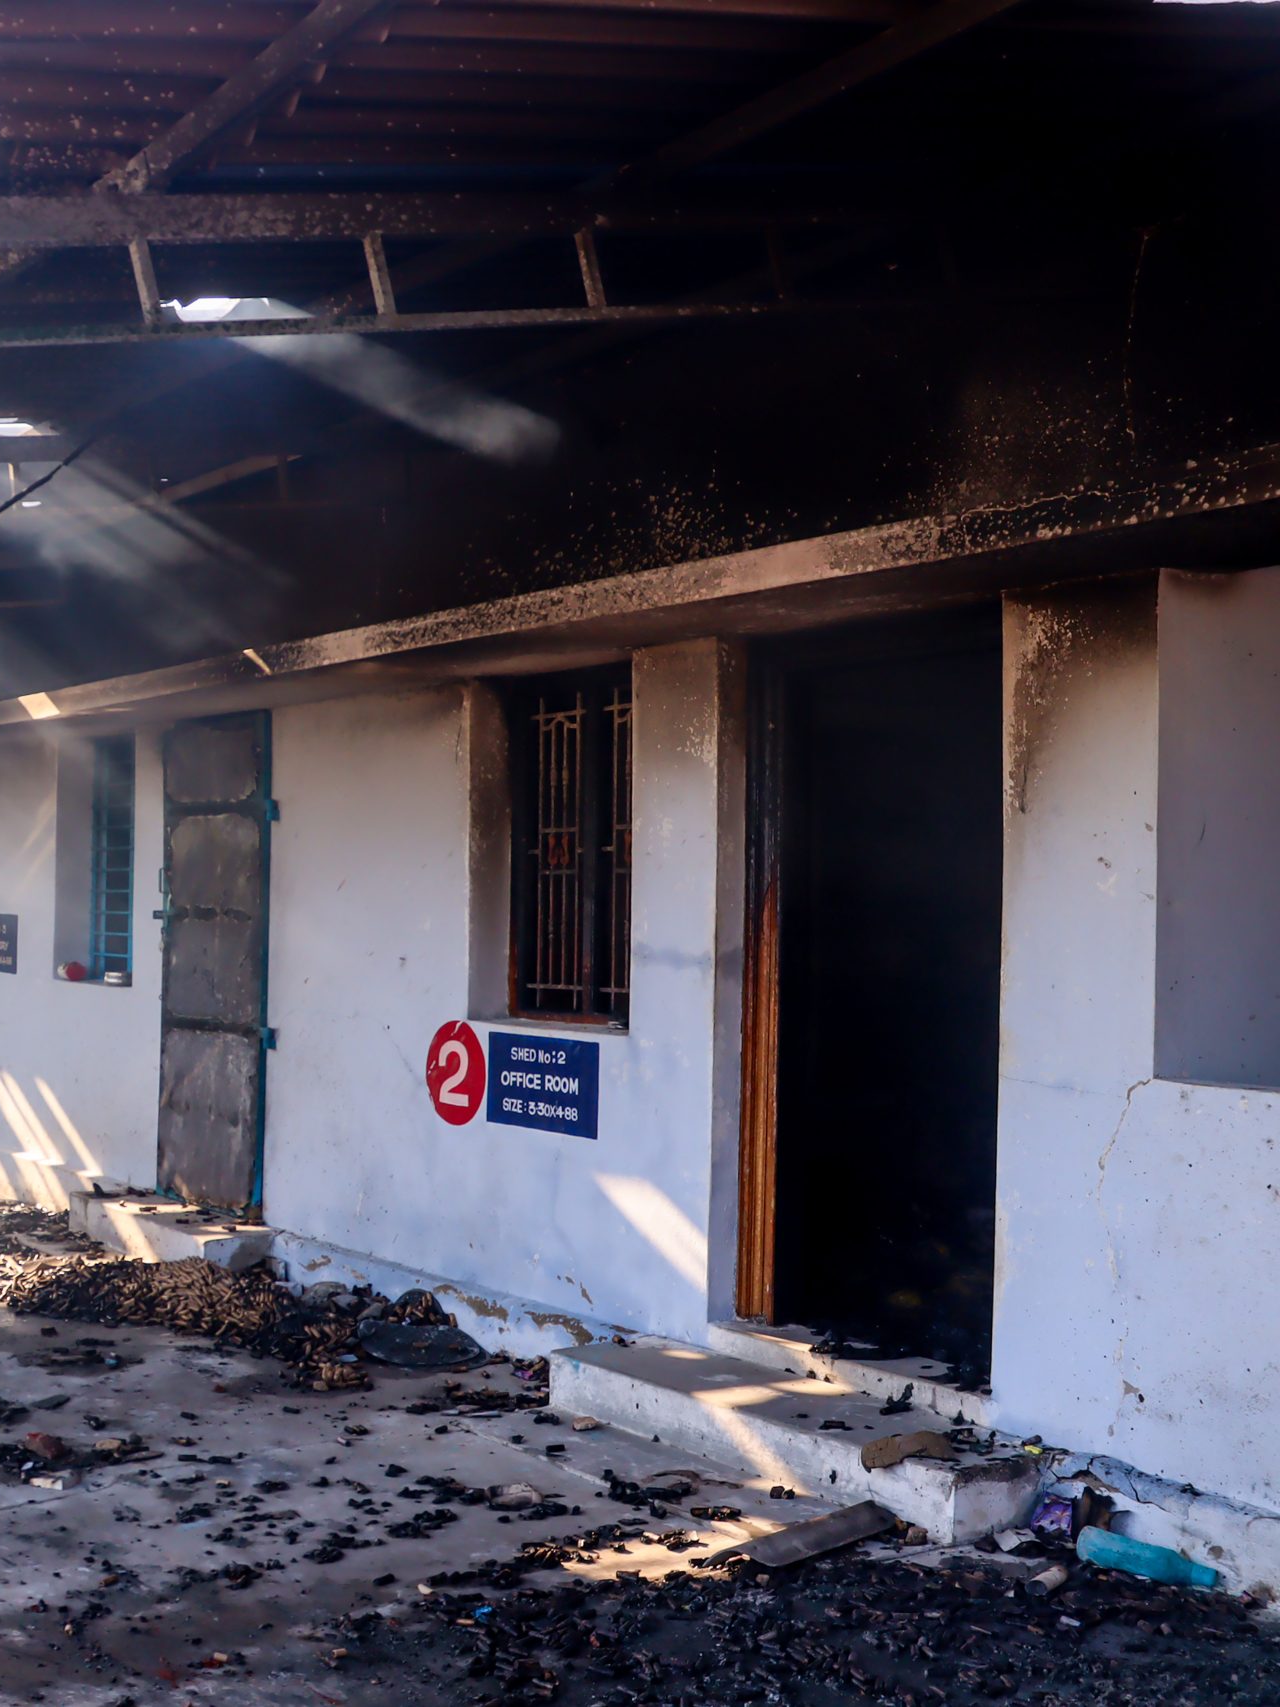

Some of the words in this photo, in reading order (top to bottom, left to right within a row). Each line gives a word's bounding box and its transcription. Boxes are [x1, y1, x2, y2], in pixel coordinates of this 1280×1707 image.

[510, 1047, 537, 1062] SHED
[438, 1040, 469, 1107] 2
[500, 1071, 542, 1090] OFFICE
[544, 1074, 579, 1095] ROOM
